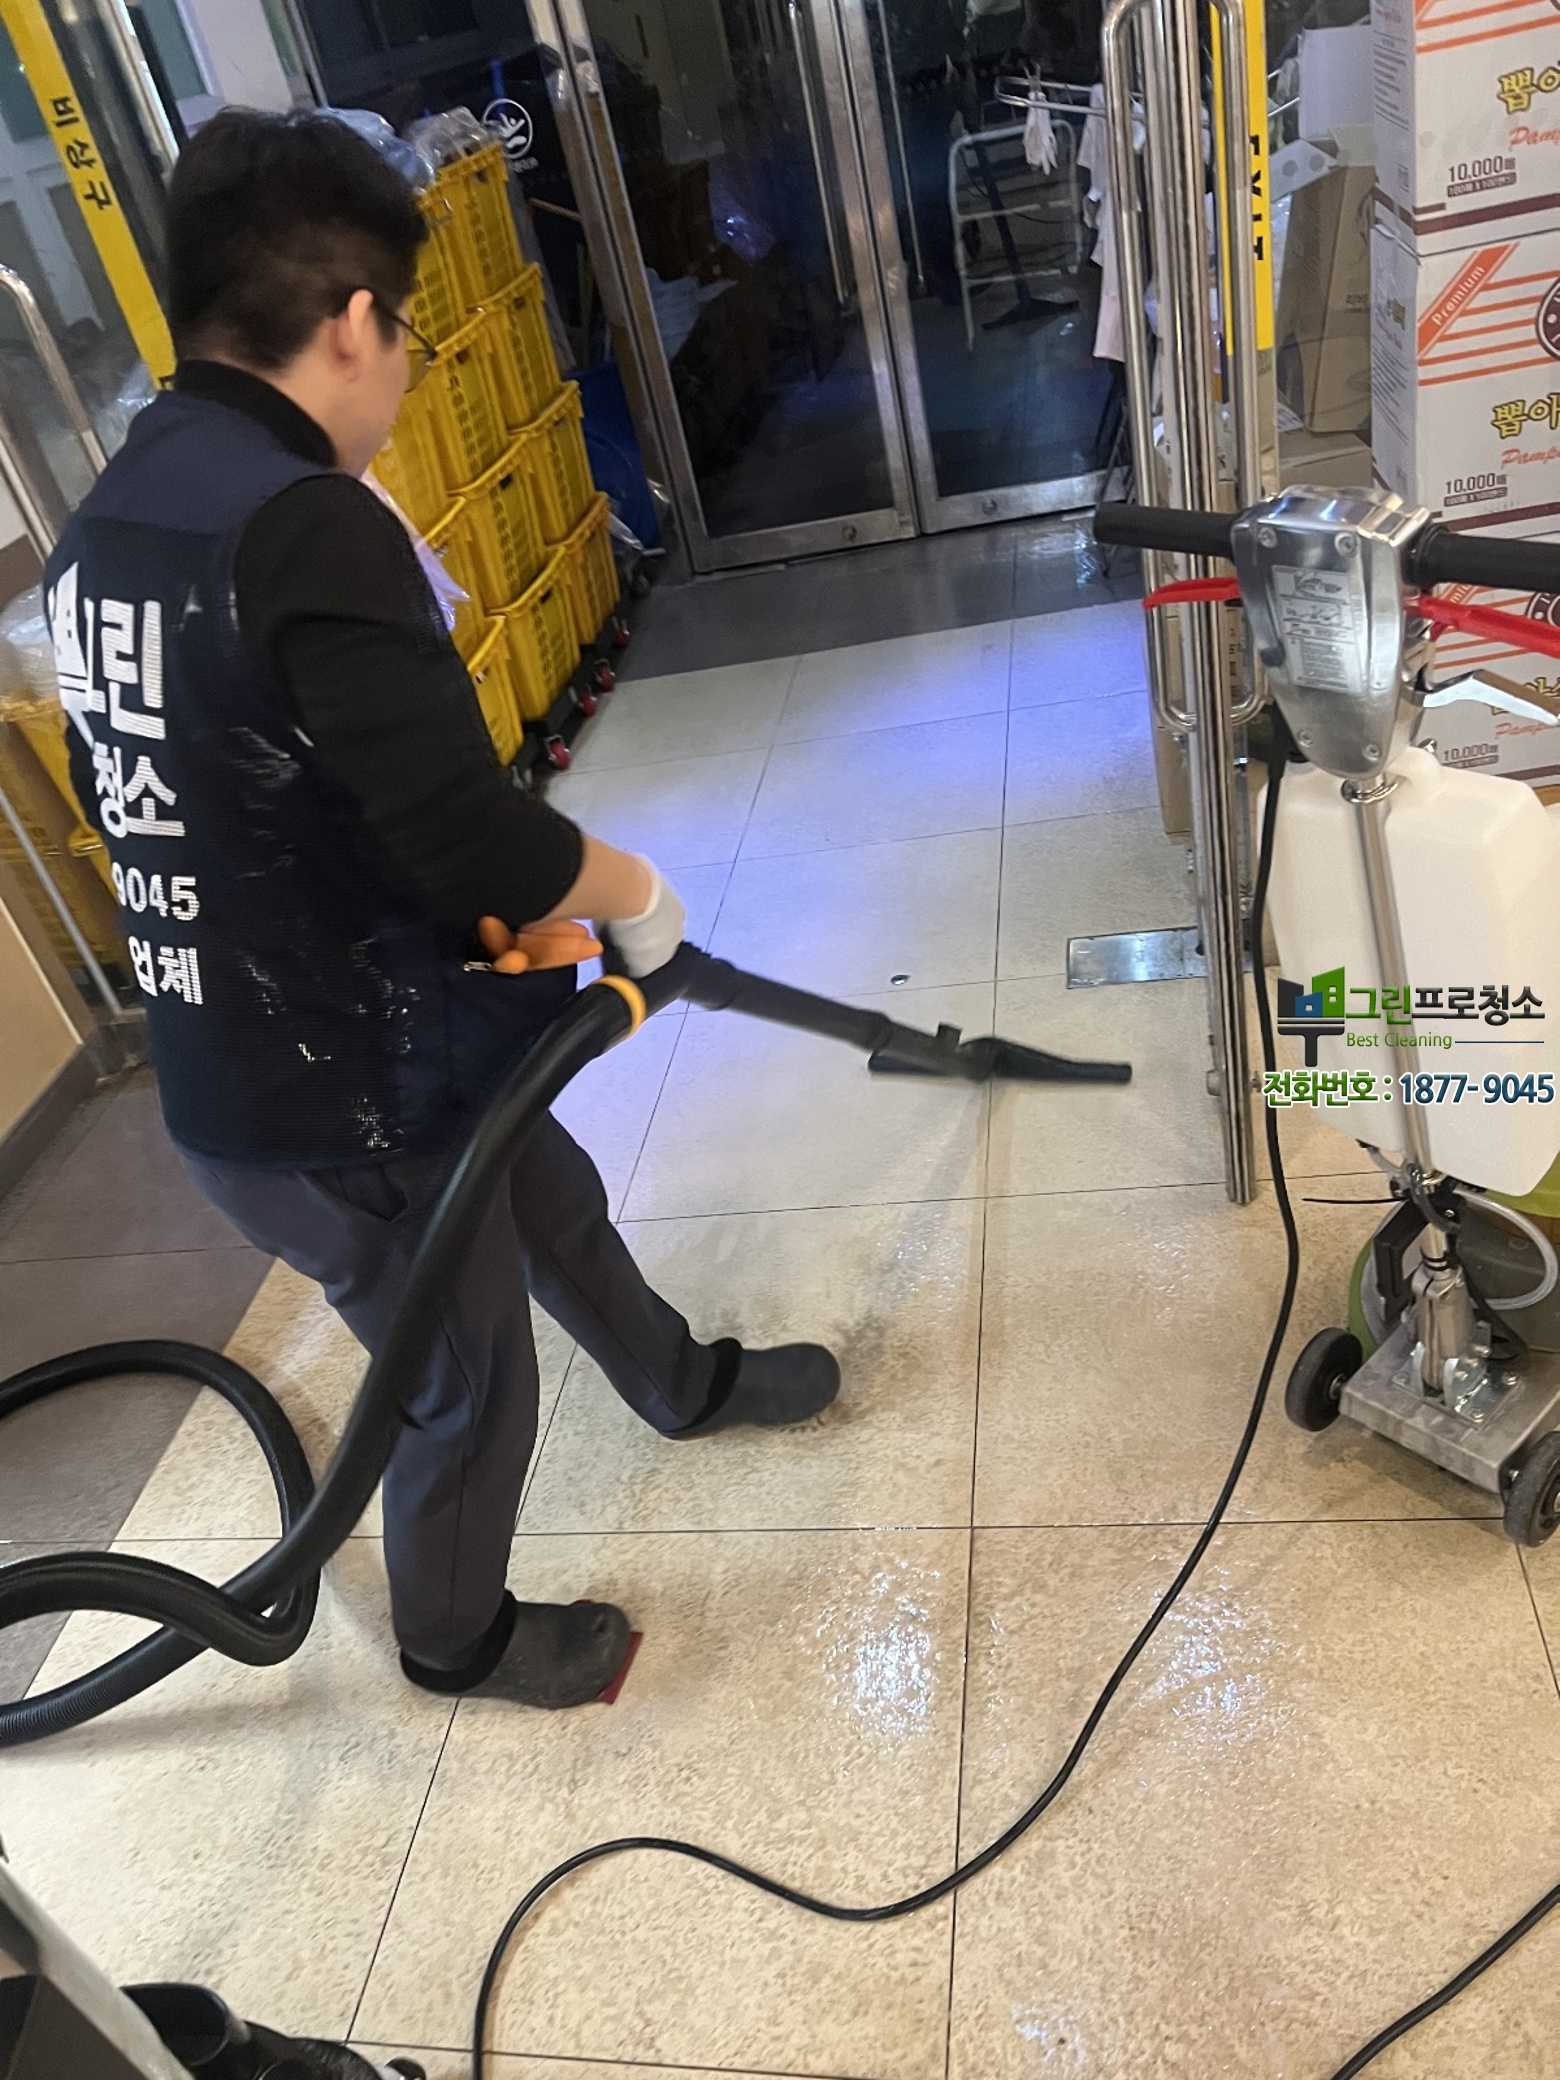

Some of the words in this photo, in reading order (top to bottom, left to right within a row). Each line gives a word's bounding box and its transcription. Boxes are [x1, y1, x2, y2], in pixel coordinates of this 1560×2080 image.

[50, 96, 112, 210] 비상구
[1431, 266, 1486, 327] Premium
[92, 742, 186, 839] 청소
[111, 862, 200, 921] 9045
[128, 936, 203, 1005] 업체
